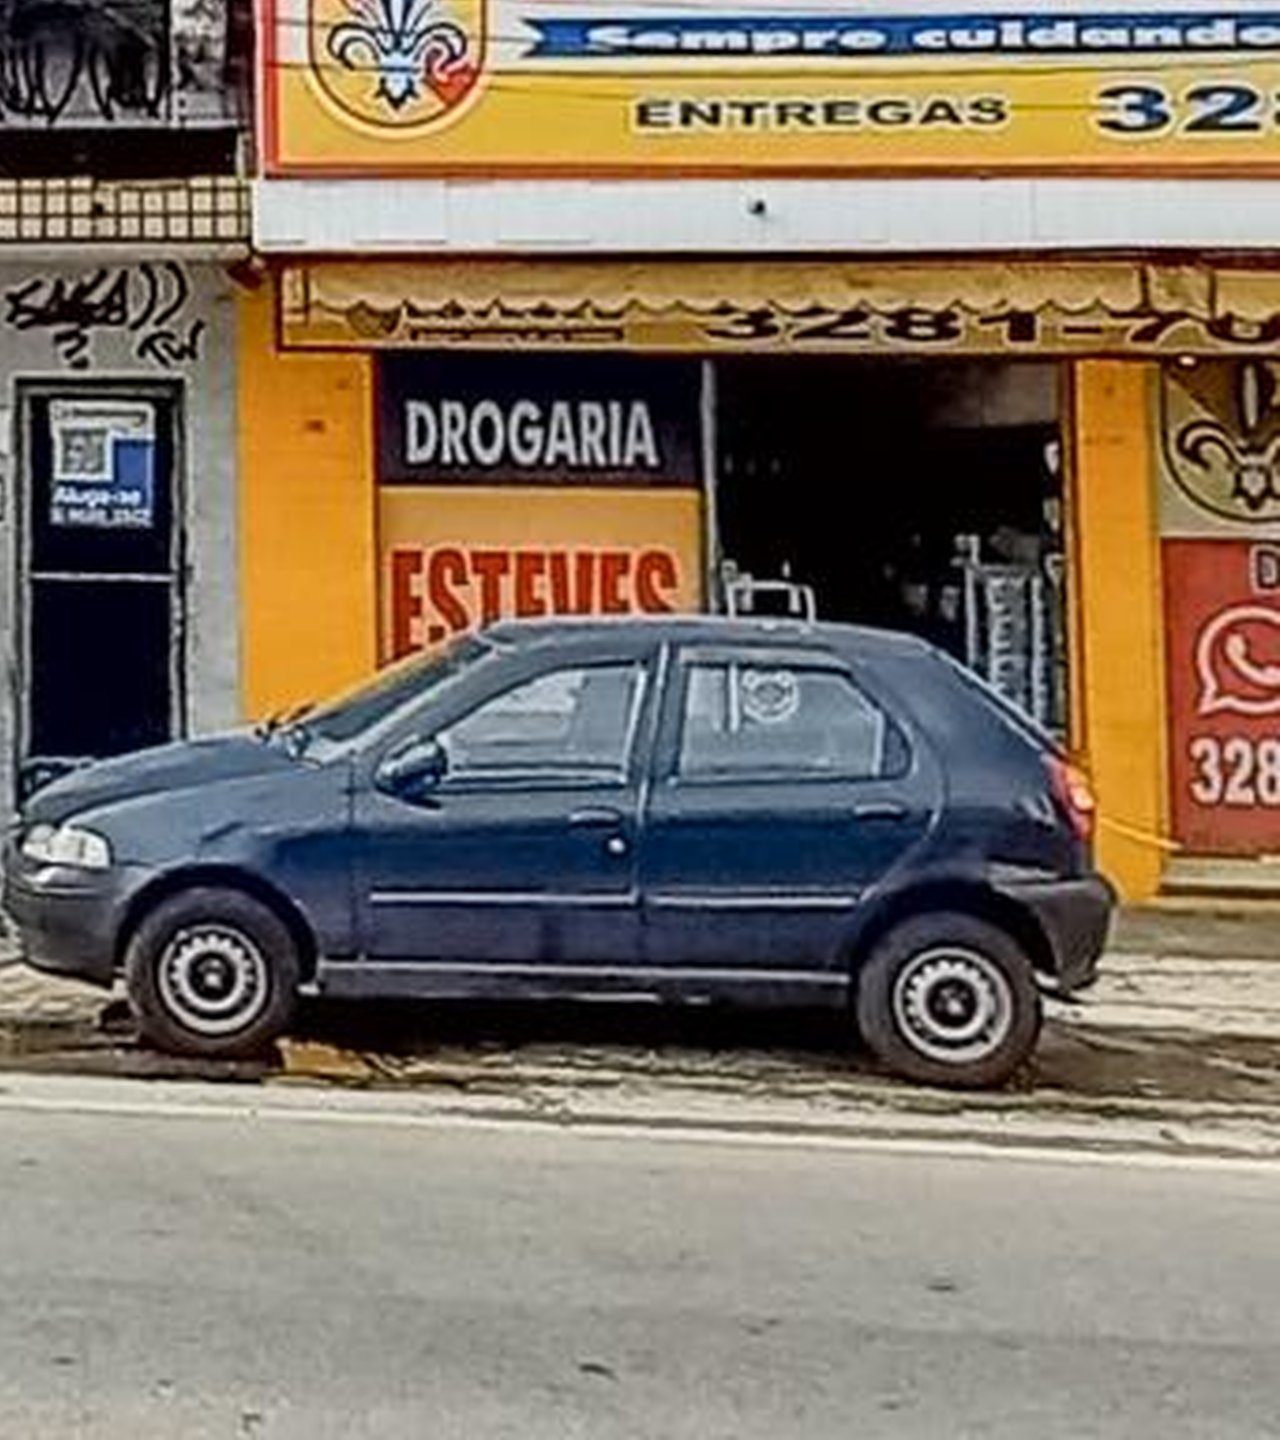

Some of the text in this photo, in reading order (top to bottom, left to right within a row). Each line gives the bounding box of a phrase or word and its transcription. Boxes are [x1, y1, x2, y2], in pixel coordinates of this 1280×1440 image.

[587, 19, 1280, 53] Sempre cuidando
[635, 84, 1280, 133] ENTREGAS 32
[405, 398, 659, 467] DROGARIA
